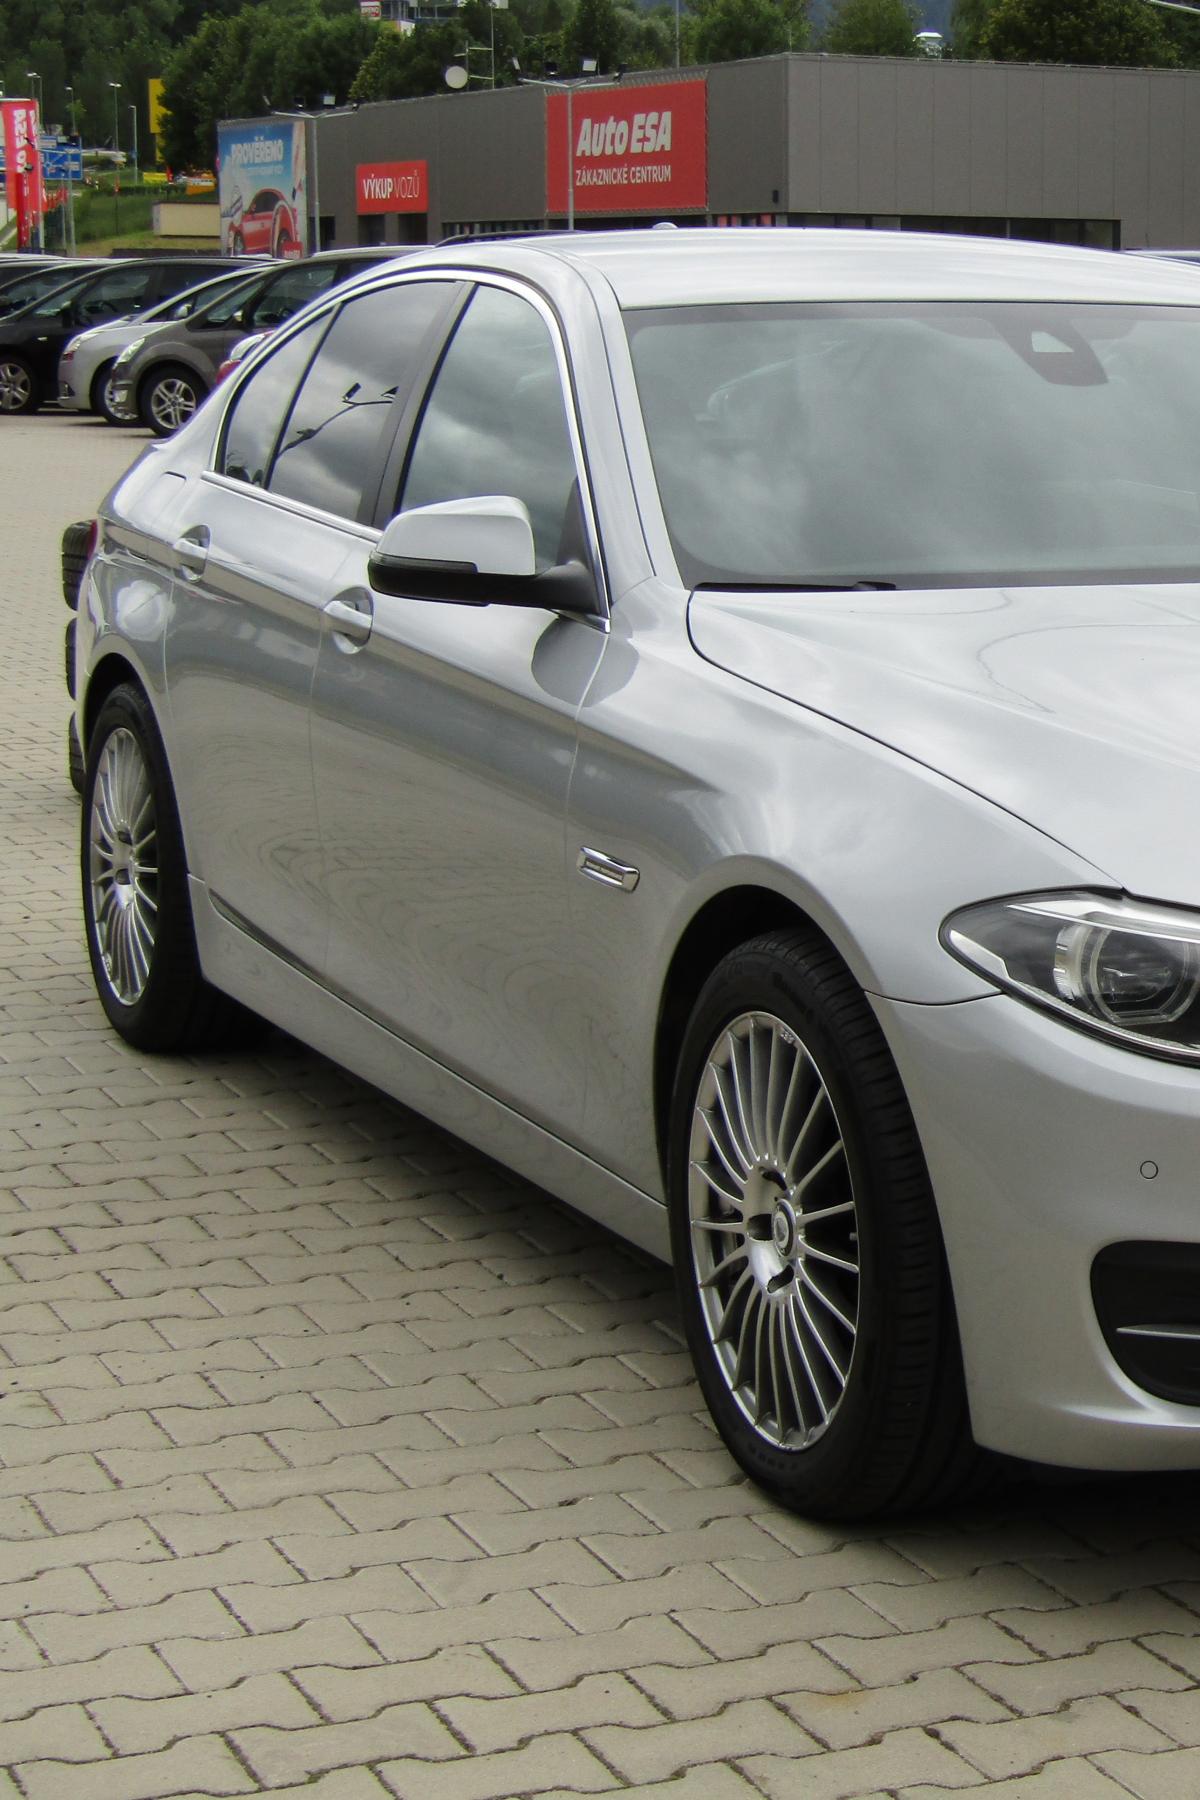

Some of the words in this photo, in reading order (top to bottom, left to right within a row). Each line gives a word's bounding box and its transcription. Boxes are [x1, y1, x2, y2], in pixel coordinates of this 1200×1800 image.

[576, 116, 629, 157] Auto
[630, 111, 672, 153] ESA
[362, 173, 394, 200] VÝKUP
[394, 169, 420, 199] VOZŮ
[576, 163, 628, 186] ZÁKAZNICKÉ
[630, 164, 671, 184] CENTRUM
